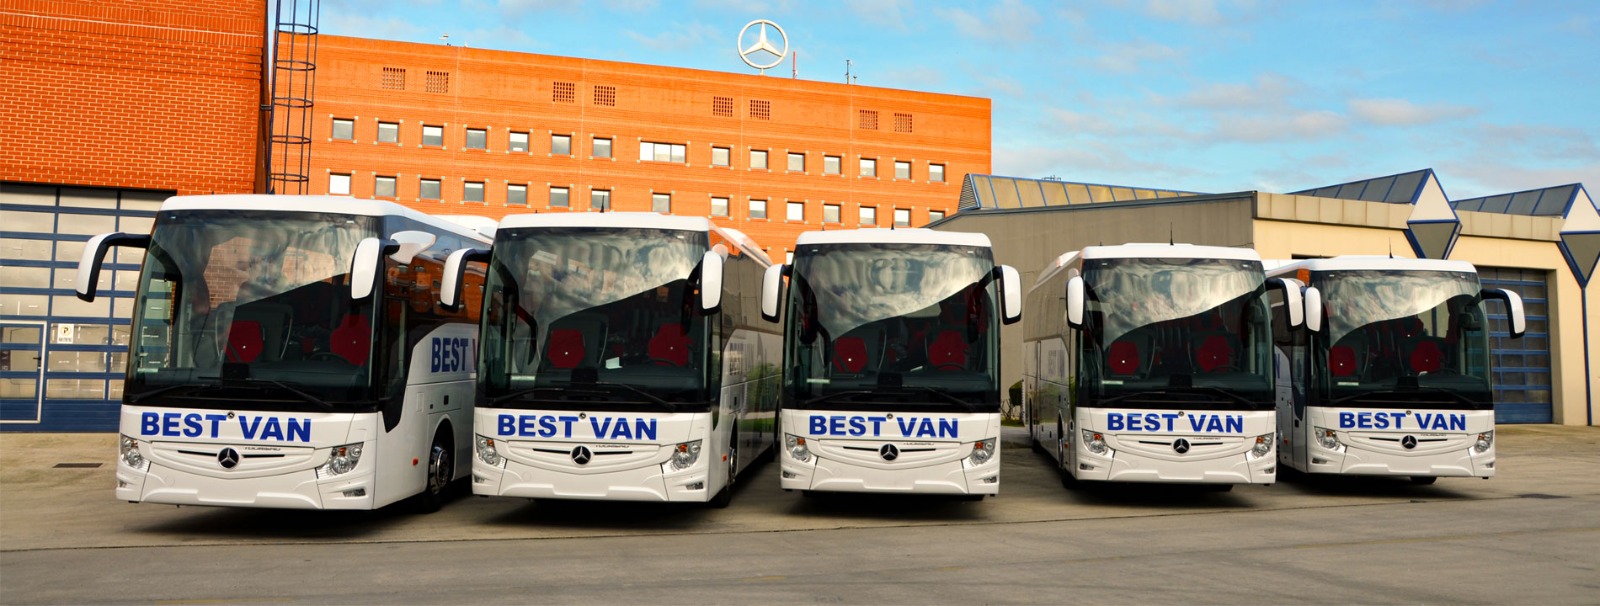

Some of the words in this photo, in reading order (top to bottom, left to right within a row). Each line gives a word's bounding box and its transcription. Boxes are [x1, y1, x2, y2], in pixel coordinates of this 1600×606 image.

[431, 337, 469, 373] BEST
[141, 411, 228, 439] BEST
[238, 415, 312, 443] VAN
[497, 413, 579, 438] BEST
[589, 416, 657, 440] VAN
[809, 415, 887, 437] BEST
[896, 416, 959, 438] VAN
[1107, 412, 1179, 432] BEST
[1188, 413, 1243, 433] VAN
[1339, 411, 1407, 429] BEST
[1415, 413, 1466, 431] VAN
